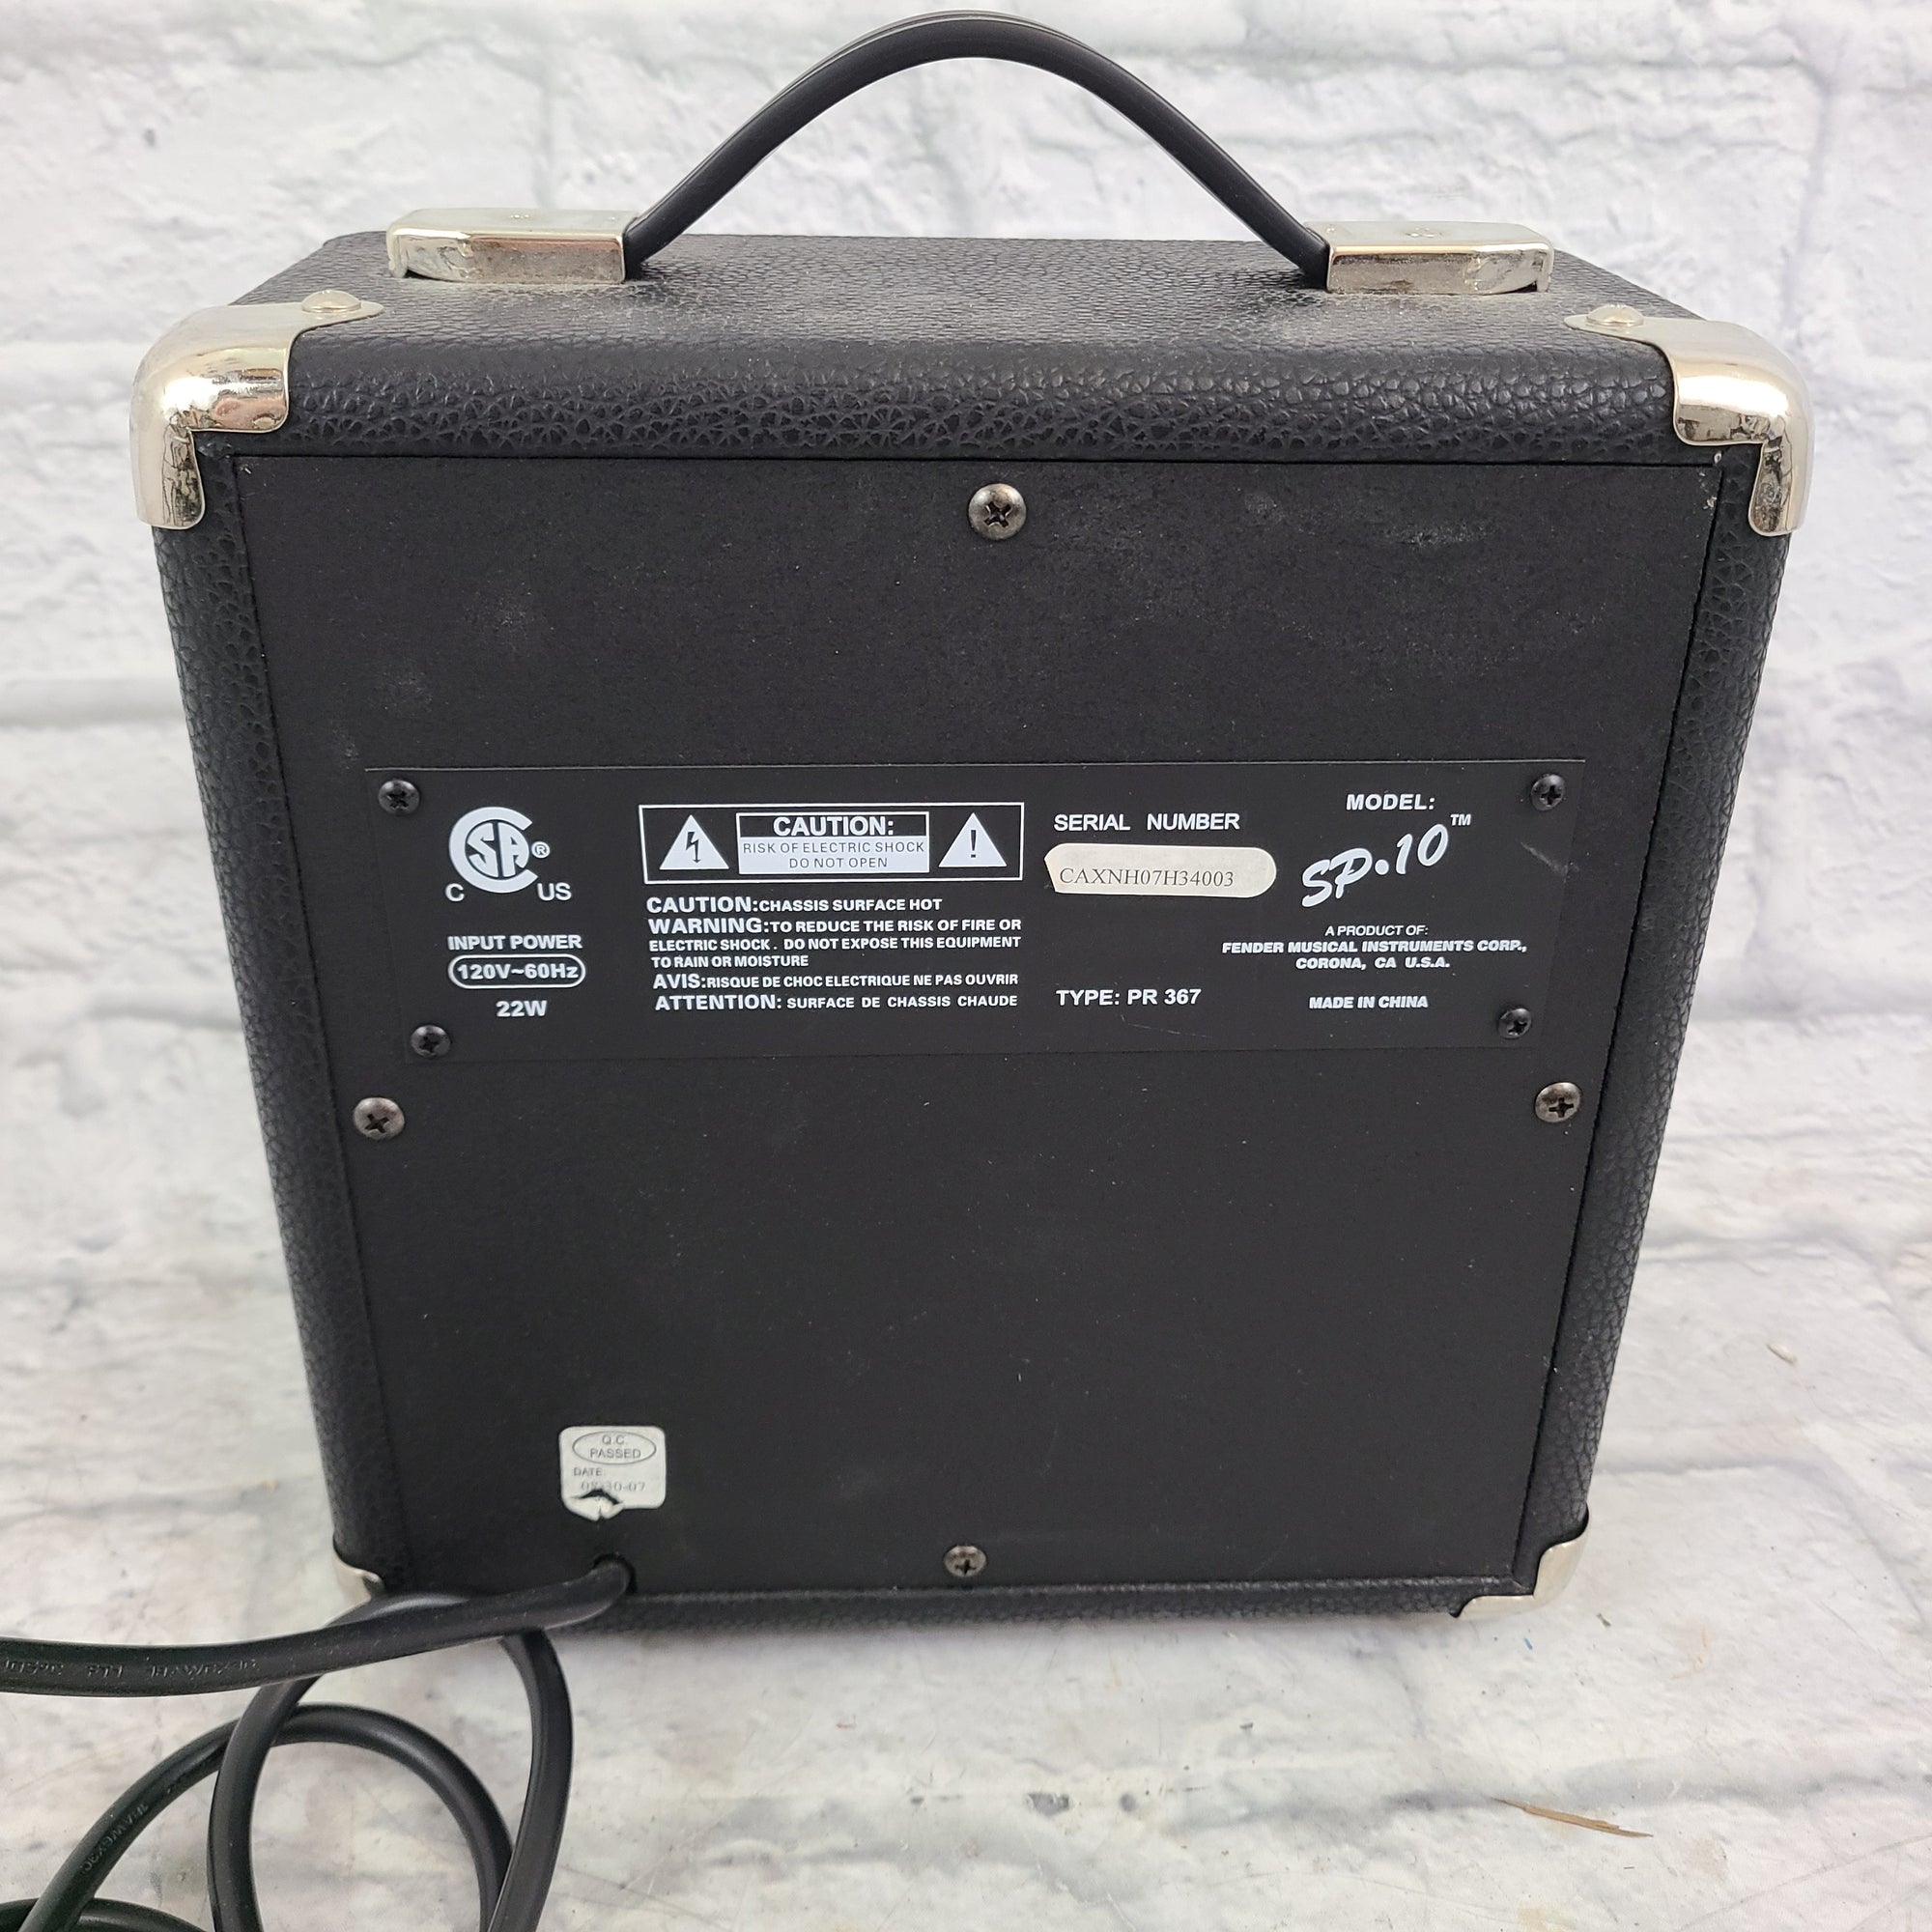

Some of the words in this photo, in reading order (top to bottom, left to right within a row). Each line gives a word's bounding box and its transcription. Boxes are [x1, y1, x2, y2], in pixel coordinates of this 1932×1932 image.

[1346, 793, 1435, 810] MODEL:
[773, 815, 895, 837] CAUTION:
[1053, 813, 1131, 832] SERIAL
[1147, 812, 1240, 831] NUMBER
[743, 842, 776, 854] RISK
[780, 842, 798, 853] OF
[803, 841, 870, 853] ELECTRIC
[875, 841, 924, 853] SHOCK
[789, 858, 810, 868] DO
[813, 857, 844, 868] NOT
[848, 857, 888, 868] OPEN
[1060, 867, 1234, 887] CAXNH07H34003
[444, 882, 466, 902] C
[536, 881, 573, 901] US
[832, 898, 906, 912] SURFACE
[909, 898, 943, 911] HOT
[795, 920, 861, 933] REDUCE
[862, 920, 895, 932] THE
[896, 919, 934, 932] RISK
[936, 919, 959, 931] OF
[961, 919, 996, 931] FIRE
[998, 919, 1022, 931] OR
[1324, 925, 1335, 937] A
[1336, 924, 1405, 937] PRODUCT
[1405, 924, 1429, 936] OF:
[447, 934, 507, 951] INPUT
[509, 934, 583, 950] POWER
[648, 938, 719, 952] ELECTRIC
[783, 938, 806, 951] DO
[808, 937, 839, 951] NOT
[840, 936, 898, 950] EXPOSE
[900, 936, 934, 950] THIS
[936, 936, 1022, 949] EQUIPMENT
[1221, 941, 1285, 954] FENDER
[1287, 940, 1359, 953] MUSICAL
[1361, 939, 1475, 952] INSTRUMENTS
[1476, 939, 1527, 953] CORP.,
[650, 955, 672, 969] TO
[673, 954, 709, 968] RAIN
[710, 955, 732, 968] OR
[733, 954, 810, 968] MOISTURE
[1295, 956, 1367, 971] CORONA,
[1374, 956, 1398, 969] CA
[1405, 955, 1451, 969] U.S.A.
[457, 962, 580, 980] 120V~60Hz
[761, 976, 781, 988] DE
[782, 975, 823, 988] CHOC
[825, 974, 911, 987] ELECTRIQUE
[913, 974, 933, 986] NE
[934, 974, 963, 986] PAS
[964, 973, 1019, 985] OUVRIR
[654, 993, 782, 1011] ATTENTION:
[786, 996, 855, 1009] SURFACE
[861, 996, 881, 1009] DE
[887, 995, 952, 1008] CHASSIS
[956, 995, 1018, 1008] CHAUDE
[1055, 989, 1121, 1007] TYPE:
[1126, 988, 1158, 1006] PR
[1163, 988, 1203, 1006] 367
[1308, 996, 1355, 1009] MADE
[1356, 995, 1377, 1009] IN
[1378, 995, 1429, 1009] CHINA
[496, 1000, 548, 1017] 22W
[602, 1435, 628, 1445] Q.C.
[590, 1448, 641, 1459] PASSED
[572, 1466, 607, 1477] DATE:
